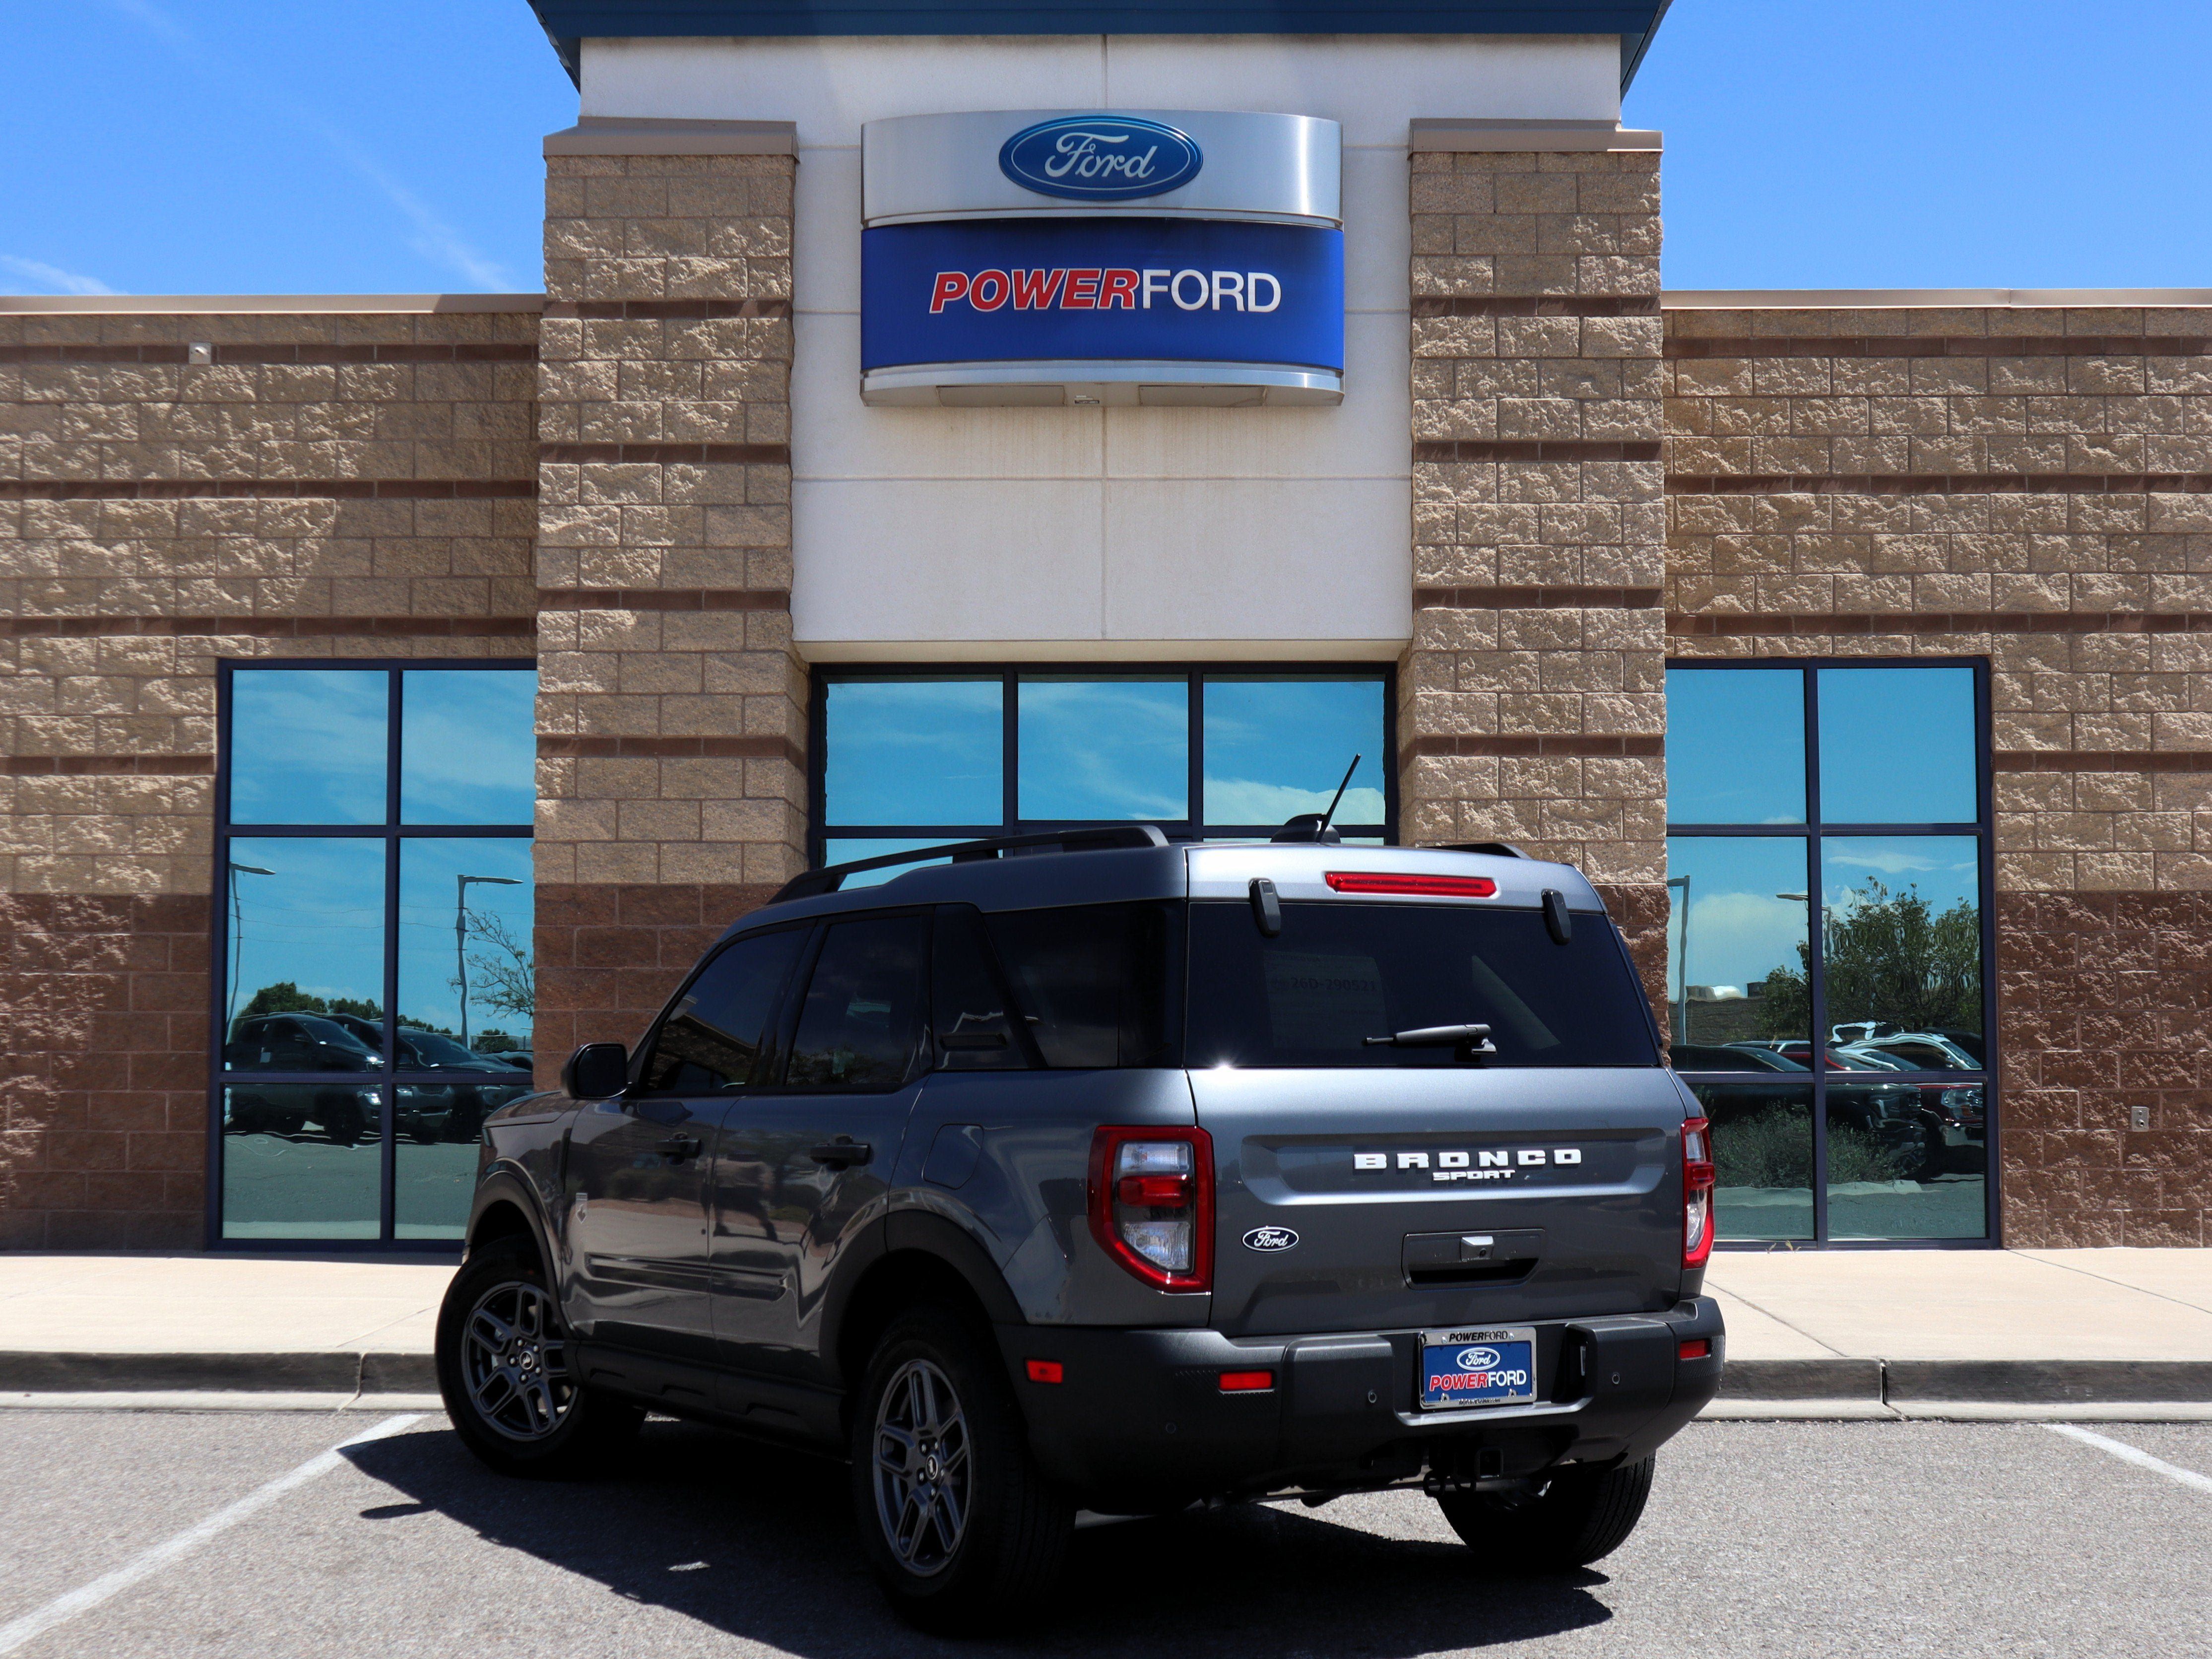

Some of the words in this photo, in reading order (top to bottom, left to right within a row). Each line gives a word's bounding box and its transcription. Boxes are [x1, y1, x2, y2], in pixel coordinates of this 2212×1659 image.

[1044, 132, 1158, 180] Ford
[1353, 1149, 1582, 1170] BRONCO
[1432, 1169, 1516, 1182] SPORT
[1253, 1230, 1289, 1247] Ford
[1465, 1351, 1491, 1366] Ford
